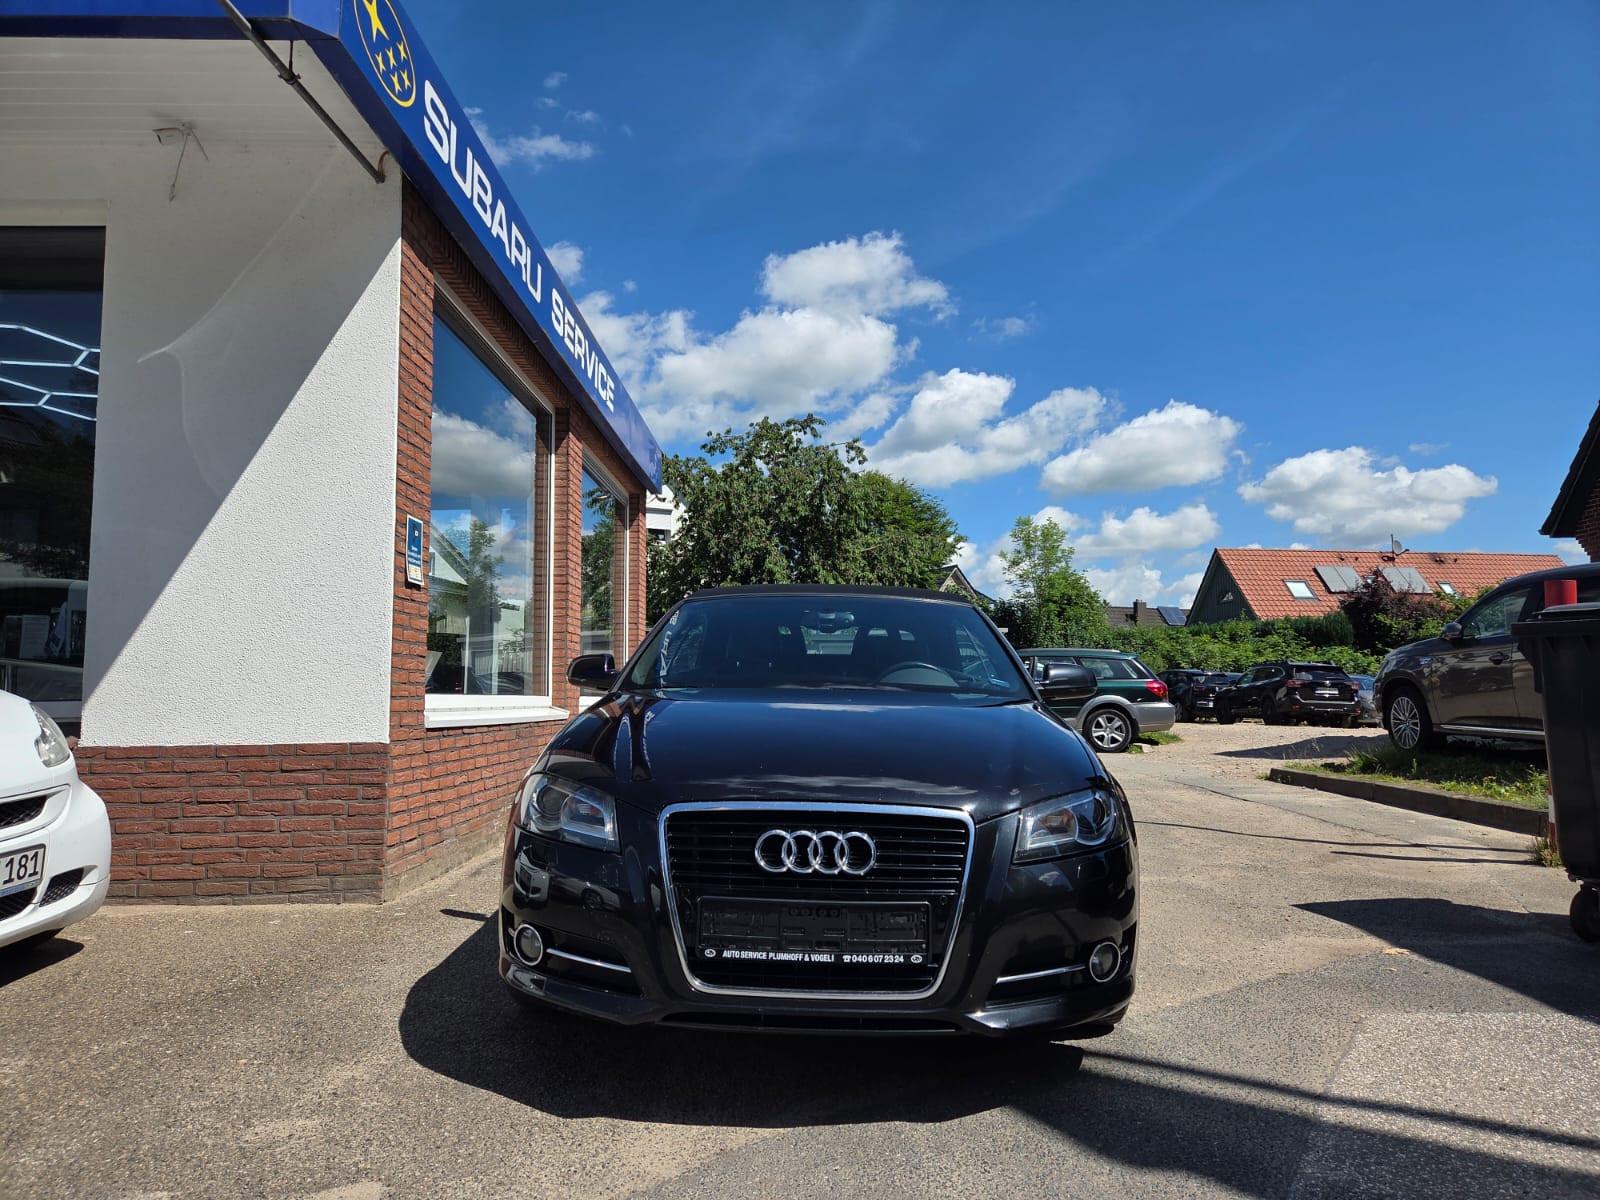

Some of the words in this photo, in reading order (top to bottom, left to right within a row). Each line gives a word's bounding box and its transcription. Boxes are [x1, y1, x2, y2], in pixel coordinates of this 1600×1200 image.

[423, 79, 542, 304] SUBARU
[551, 287, 616, 414] SERVICE
[2, 850, 39, 885] 181
[722, 950, 740, 958] AUTO
[740, 951, 767, 960] SERVICE
[768, 952, 803, 961] PLUMHOFF
[804, 954, 810, 962] &
